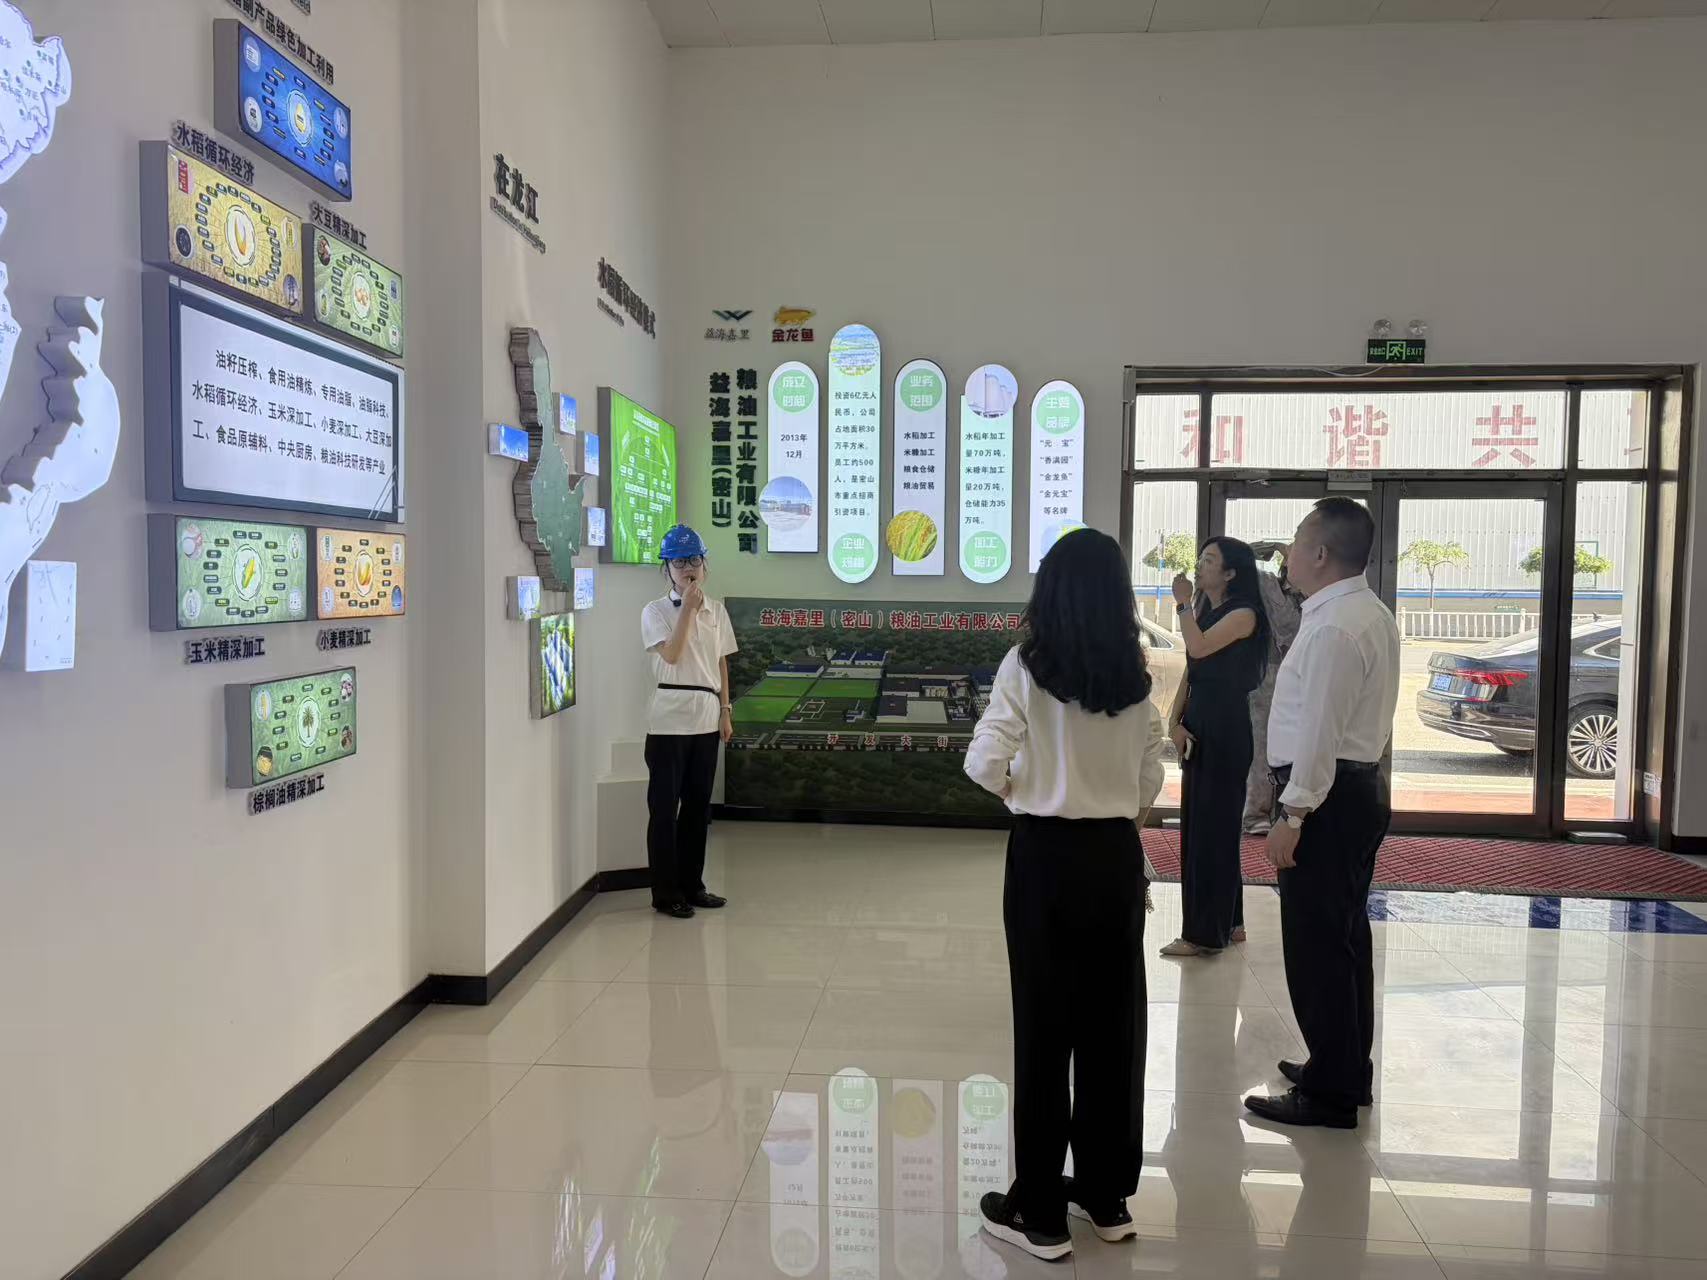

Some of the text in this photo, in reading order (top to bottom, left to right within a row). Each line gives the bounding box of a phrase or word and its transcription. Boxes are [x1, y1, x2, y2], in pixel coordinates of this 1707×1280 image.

[176, 121, 255, 184] 水稻循环经济
[312, 203, 367, 250] 大豆精深加工
[772, 328, 814, 343] 金龙鱼
[1406, 347, 1424, 356] EXIT
[834, 391, 877, 400] 投资6亿元人
[834, 425, 876, 433] 占地面积30
[780, 433, 808, 442] 2013年
[903, 432, 936, 440] 水稻加工
[965, 432, 1006, 440] 水稻年加工
[785, 450, 803, 459] 12月
[903, 449, 936, 457] 米糠加工
[736, 368, 759, 553] 粮油工业有限公司
[834, 458, 874, 467] 员工约500
[903, 465, 935, 474] 粮食仓储
[903, 482, 935, 490] 粮油贸易
[965, 499, 1006, 508] 仓储能力35
[1043, 506, 1068, 515] 等名牌
[320, 628, 372, 651] 小麦精深加工
[190, 637, 265, 664] 玉米精深加工
[252, 773, 325, 815] 棕榈油精深加工
